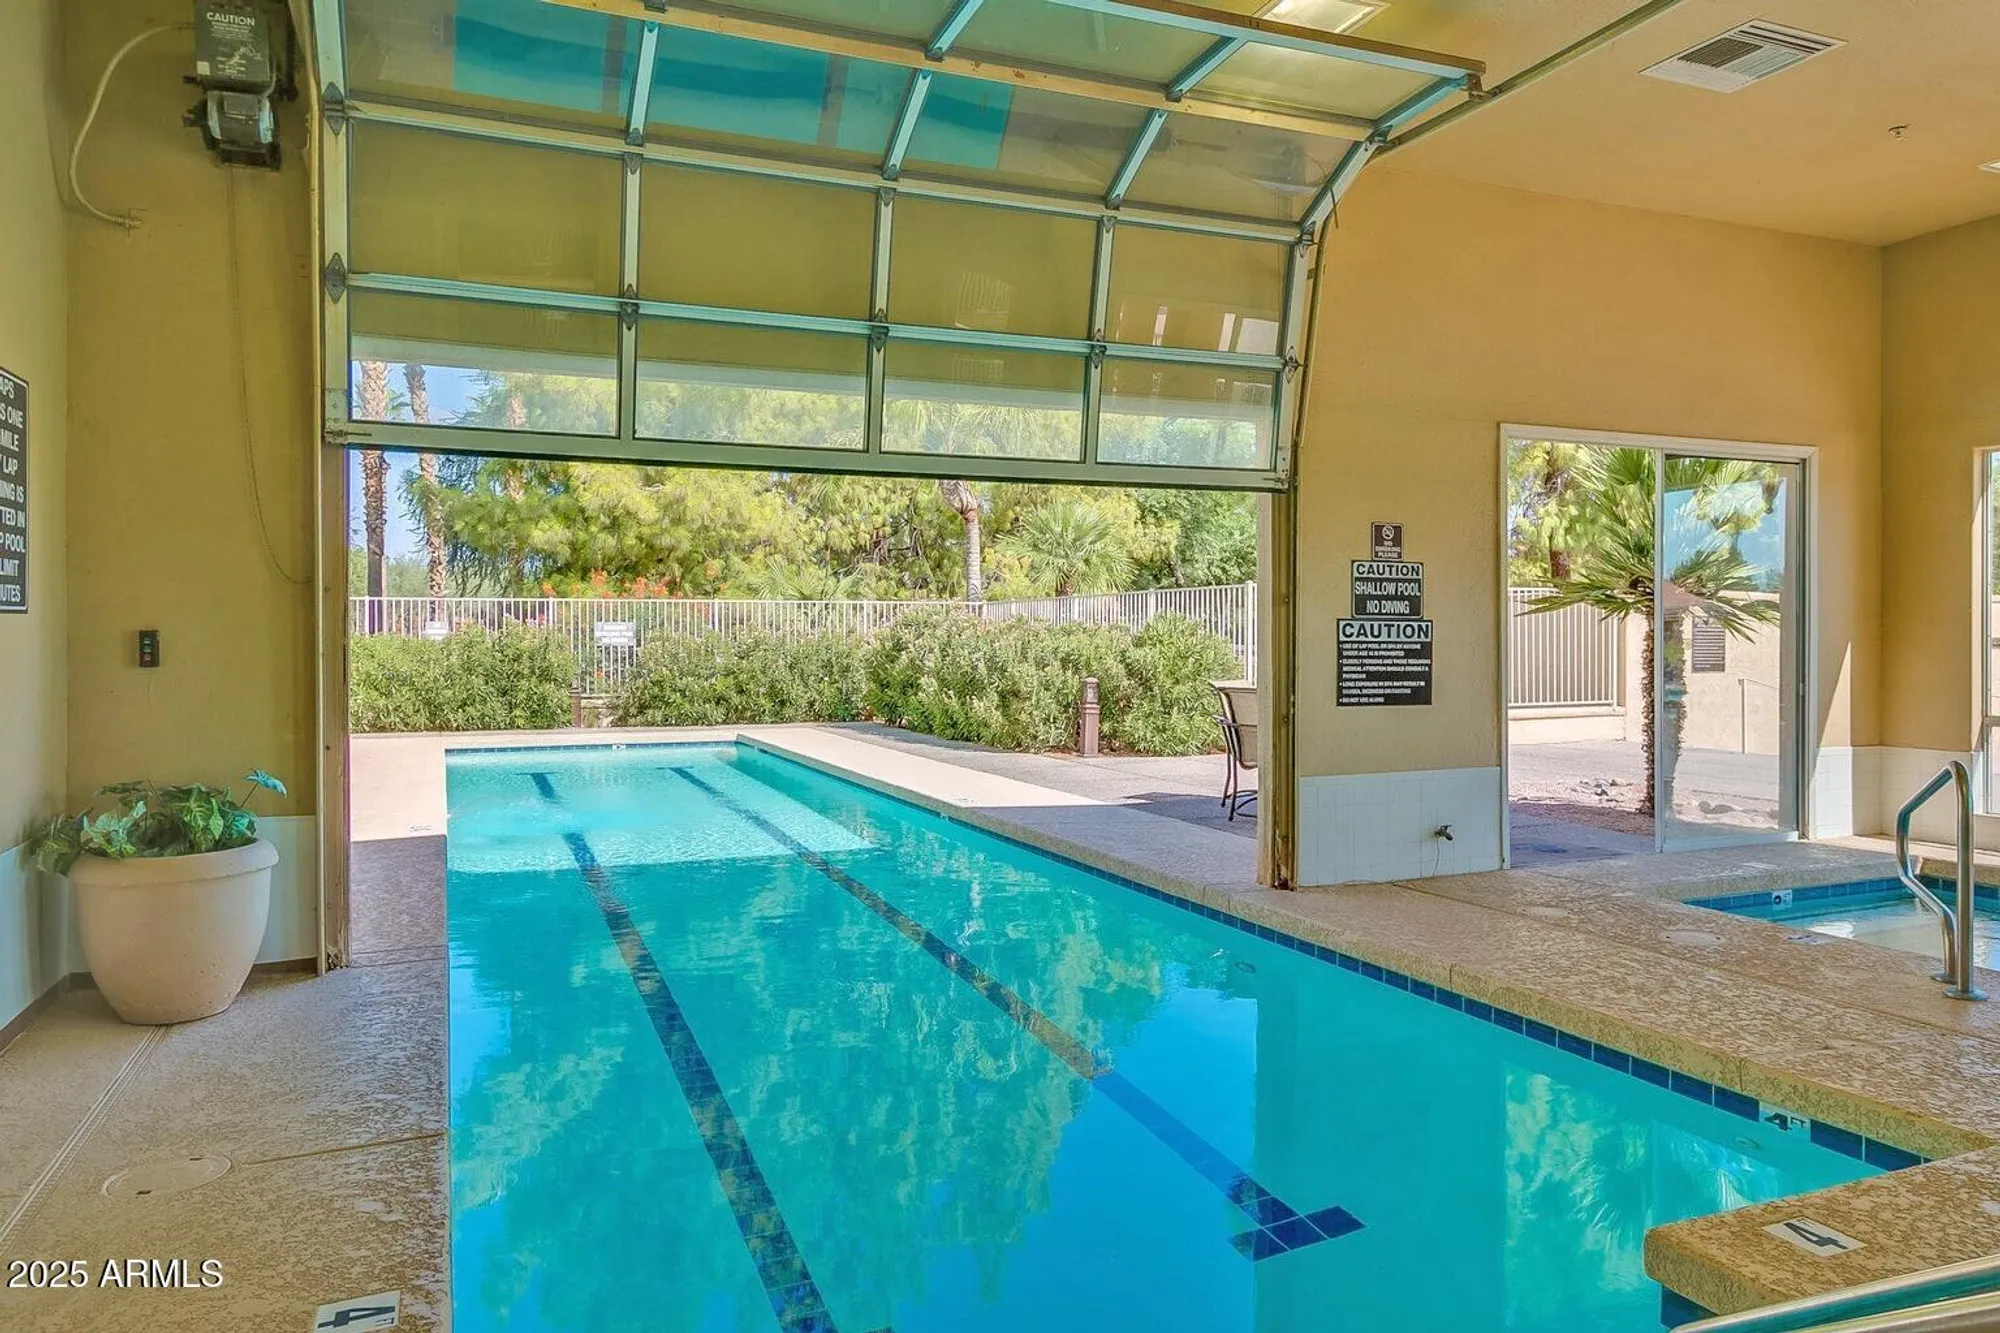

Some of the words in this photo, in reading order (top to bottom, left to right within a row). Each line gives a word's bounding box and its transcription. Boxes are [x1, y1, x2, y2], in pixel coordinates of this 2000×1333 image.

[206, 12, 256, 26] CAUTION
[7, 406, 24, 429] ONE
[0, 428, 19, 453] MILE
[3, 455, 18, 476] LAP
[16, 485, 24, 503] IS
[17, 510, 25, 528] IN
[5, 533, 25, 553] POOL
[1356, 564, 1420, 578] CAUTION
[1355, 580, 1396, 596] SHALLOW
[1398, 582, 1420, 596] POOL
[1366, 600, 1379, 613] NO
[1380, 600, 1410, 614] DIVING
[1342, 622, 1429, 639] CAUTION
[1784, 1222, 1849, 1250] 4
[318, 1306, 396, 1328] 4
